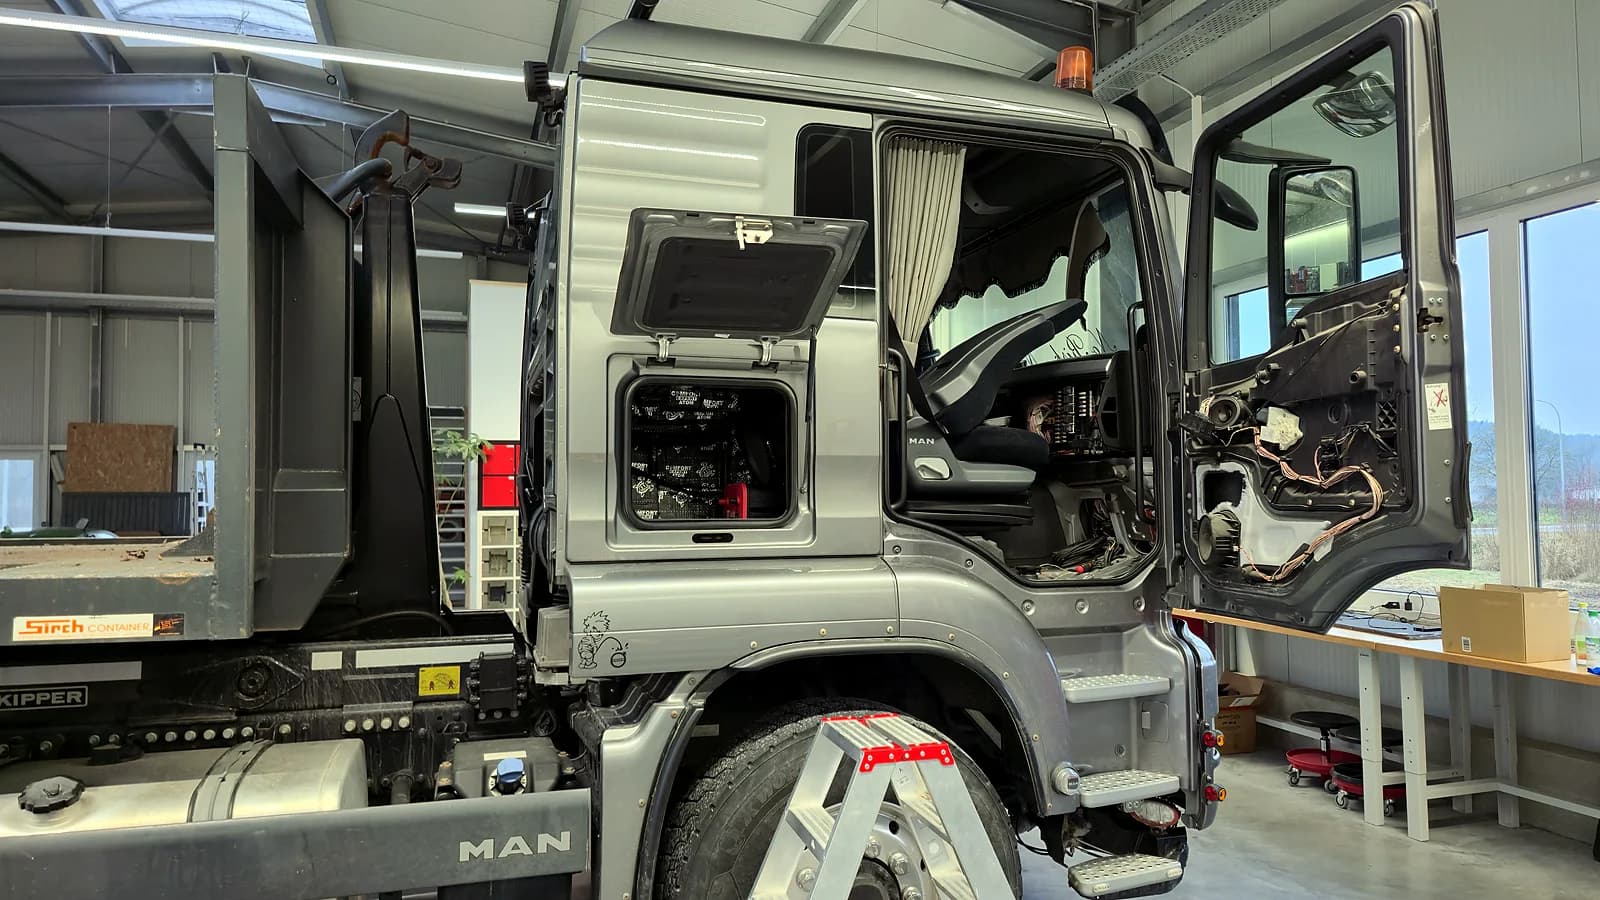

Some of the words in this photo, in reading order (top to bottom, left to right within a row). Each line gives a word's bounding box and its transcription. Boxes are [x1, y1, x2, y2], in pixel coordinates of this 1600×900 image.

[87, 622, 149, 634] CONTAINER
[0, 691, 83, 707] KIPPER
[459, 831, 571, 862] MAN
